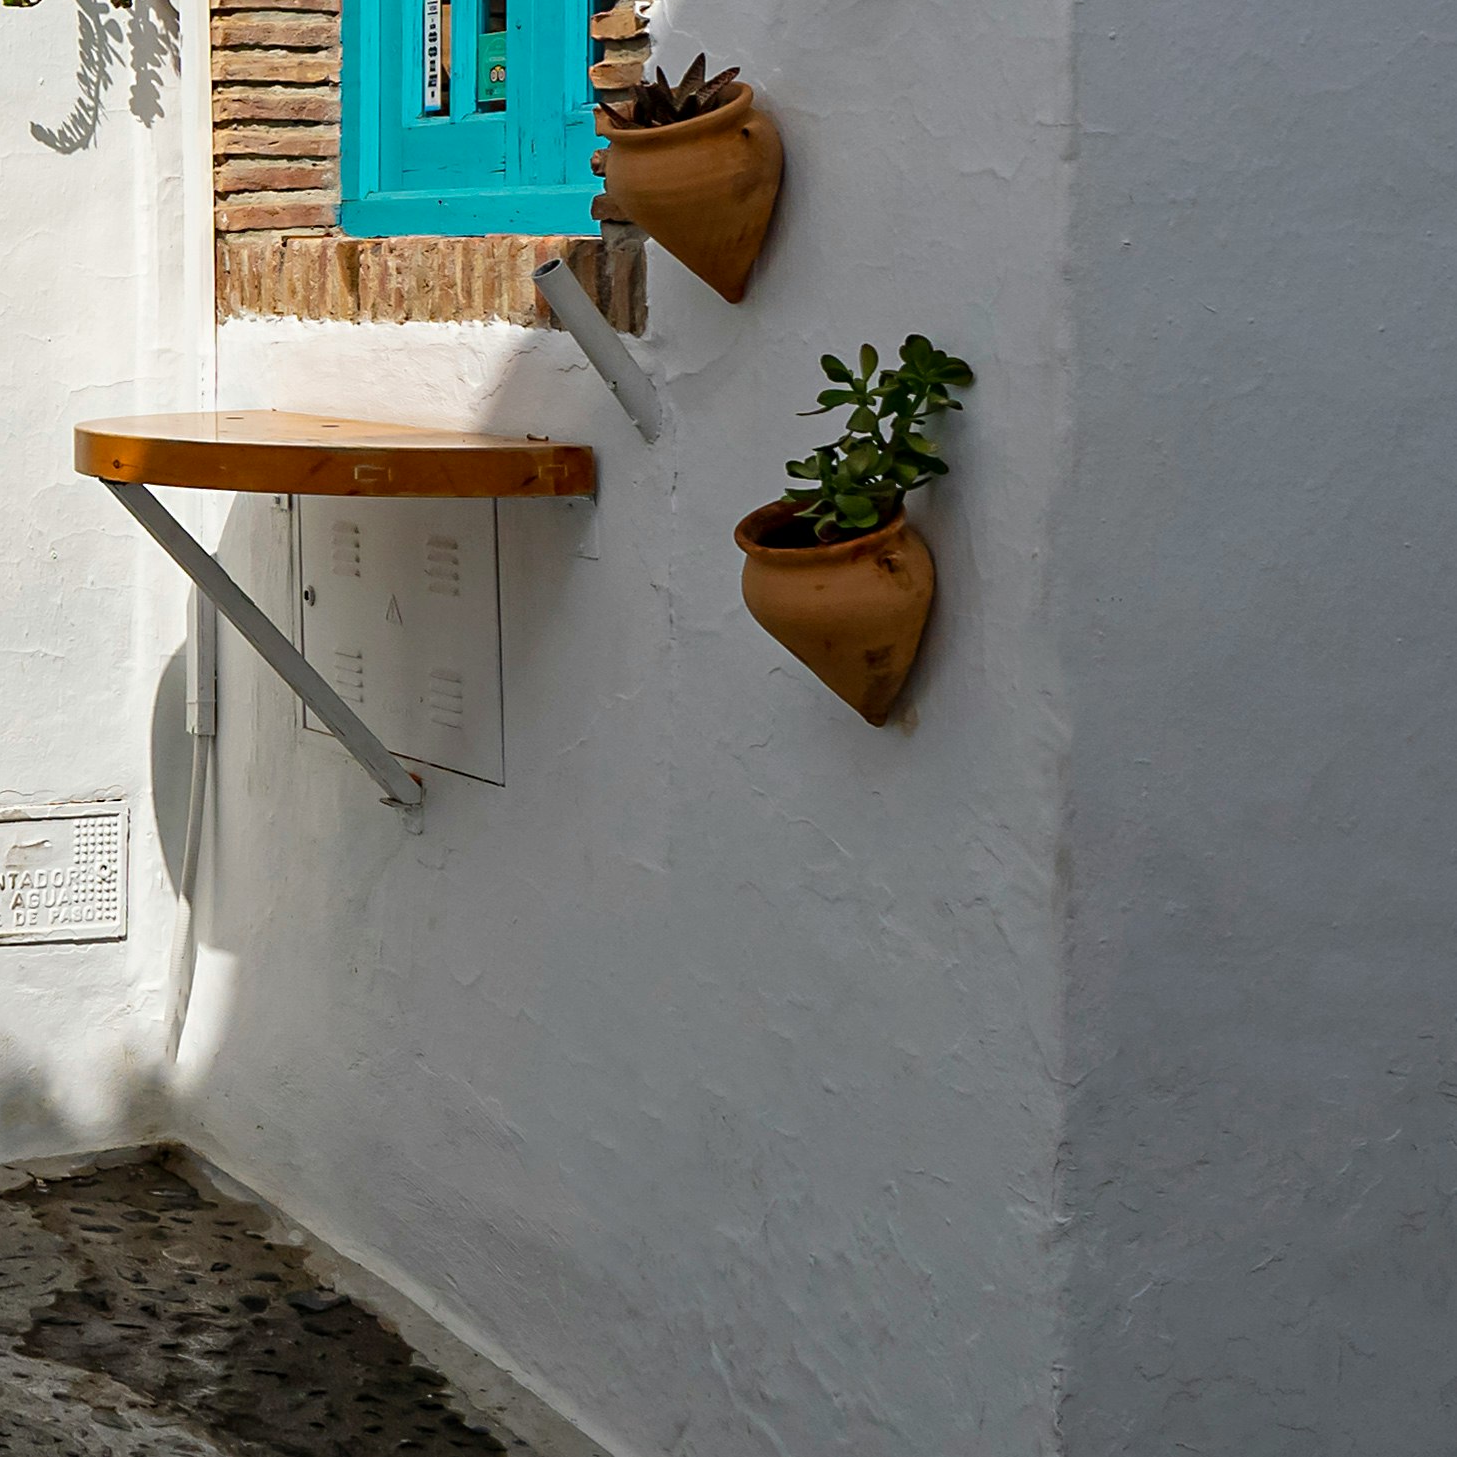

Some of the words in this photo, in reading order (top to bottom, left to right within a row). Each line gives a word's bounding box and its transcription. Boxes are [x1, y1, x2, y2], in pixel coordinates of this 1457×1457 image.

[10, 889, 71, 910] AGUA
[14, 909, 39, 927] DE
[49, 905, 95, 925] PASO
